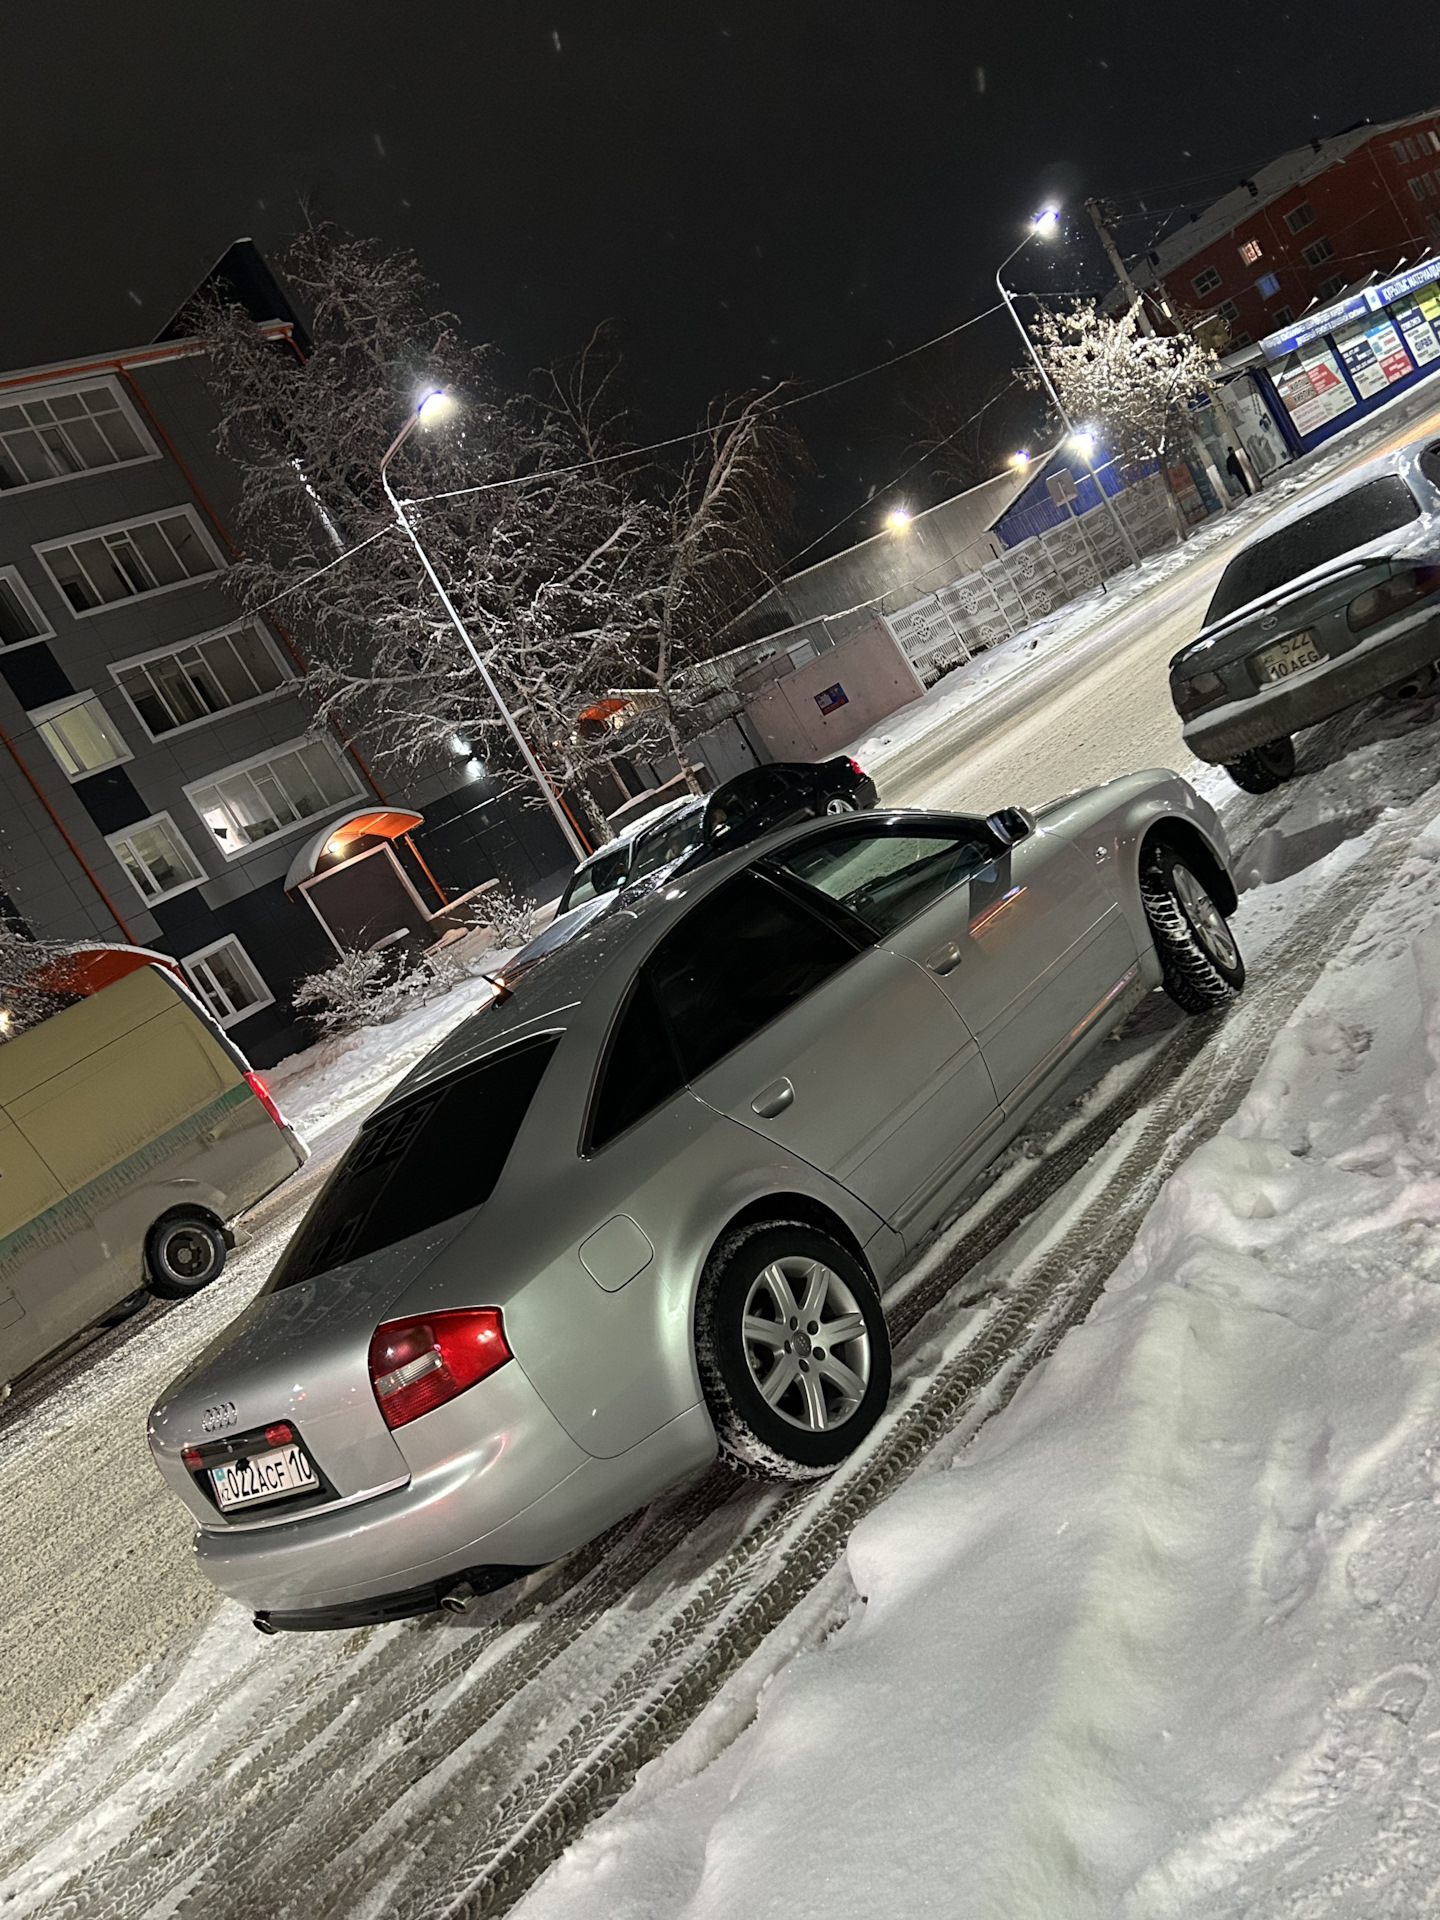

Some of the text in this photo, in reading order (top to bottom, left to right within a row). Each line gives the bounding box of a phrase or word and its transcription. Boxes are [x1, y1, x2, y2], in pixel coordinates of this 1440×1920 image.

[1270, 650, 1319, 679] 10 AEG
[288, 1449, 312, 1482] 10
